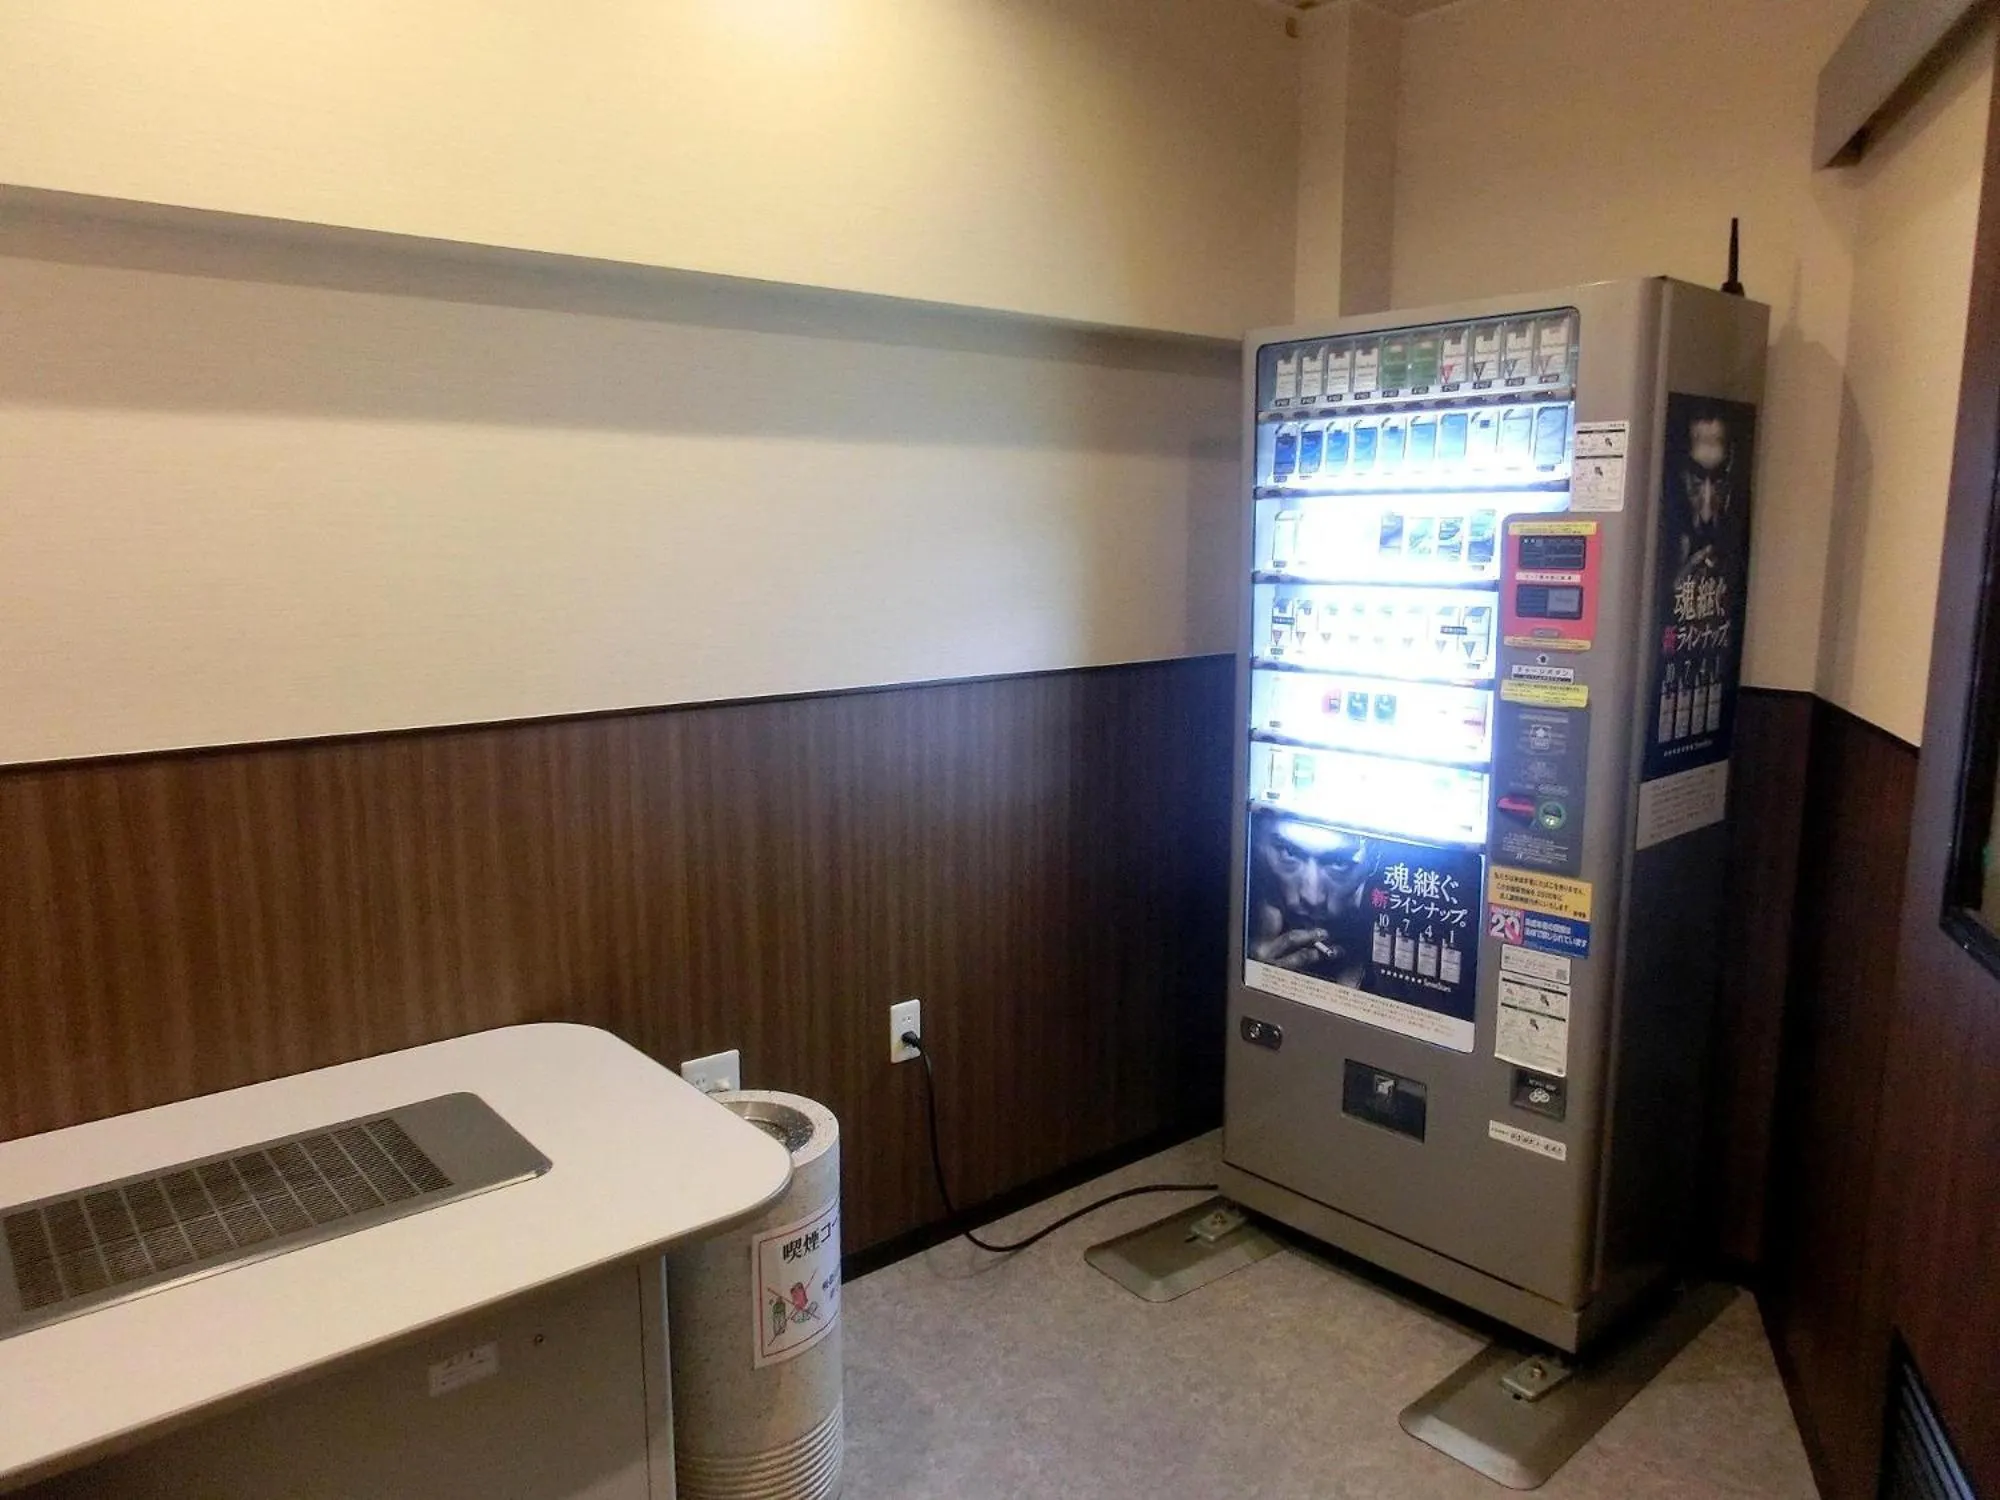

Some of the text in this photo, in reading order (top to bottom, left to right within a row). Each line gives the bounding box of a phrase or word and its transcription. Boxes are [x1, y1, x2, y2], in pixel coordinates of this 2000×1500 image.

[1379, 913, 1455, 943] 10 7 4 1
[1490, 913, 1520, 941] 20
